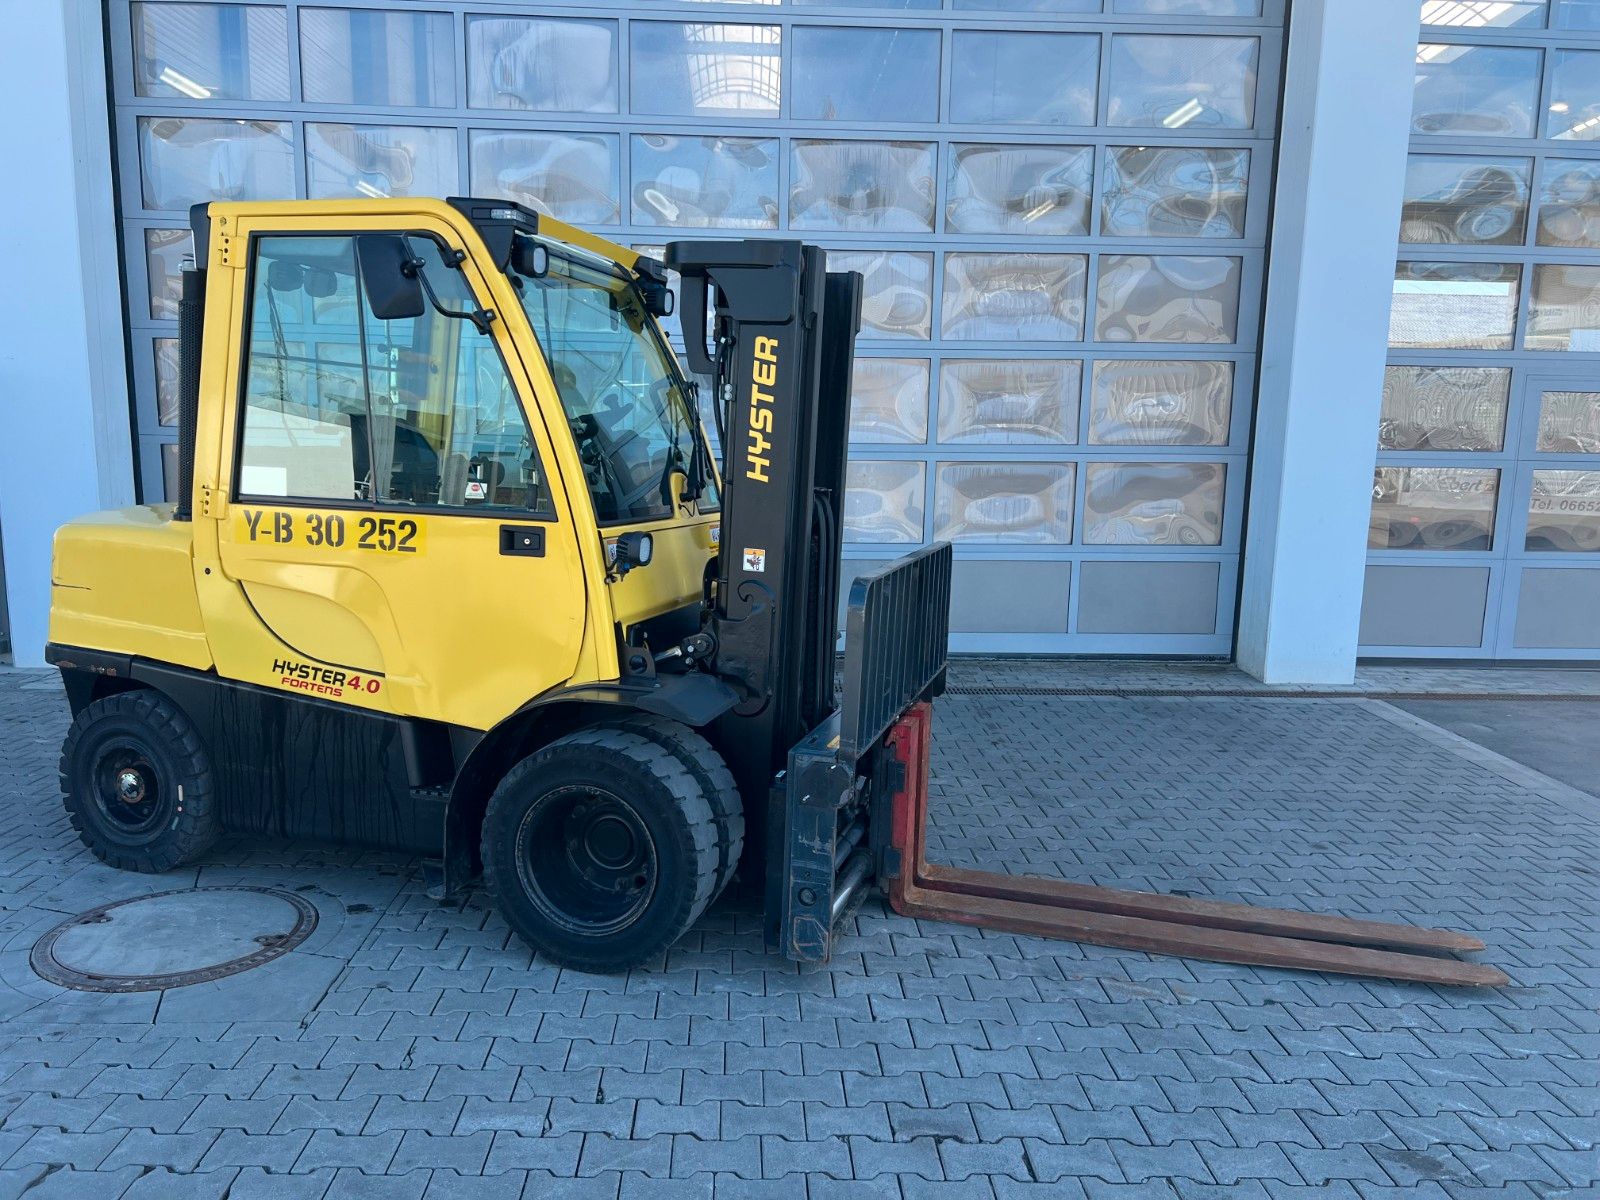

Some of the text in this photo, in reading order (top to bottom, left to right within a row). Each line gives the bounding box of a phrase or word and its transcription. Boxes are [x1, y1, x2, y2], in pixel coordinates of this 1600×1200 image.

[746, 335, 779, 483] HYSTER
[1532, 498, 1553, 510] Tel.
[244, 510, 417, 552] Y-B 30 252
[272, 659, 381, 694] HYSTER 4.0
[281, 676, 343, 697] FORTENS
